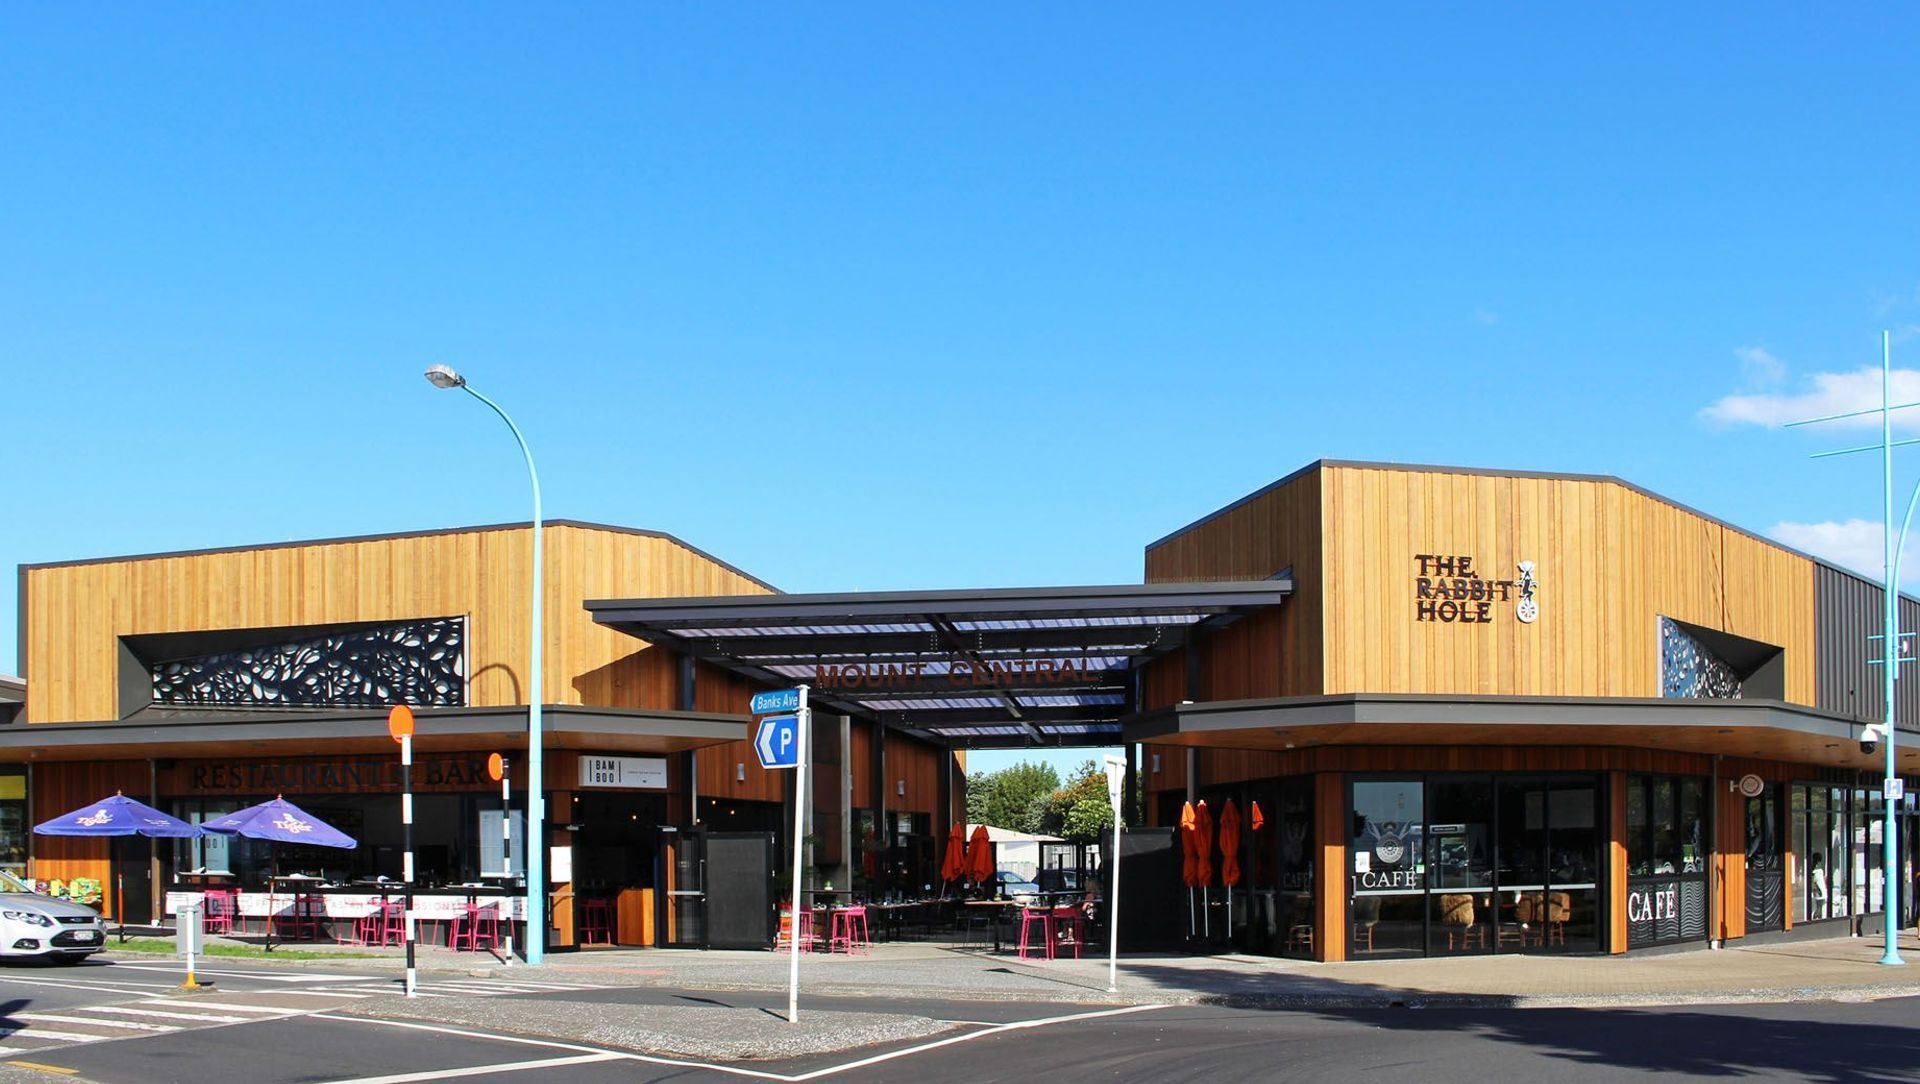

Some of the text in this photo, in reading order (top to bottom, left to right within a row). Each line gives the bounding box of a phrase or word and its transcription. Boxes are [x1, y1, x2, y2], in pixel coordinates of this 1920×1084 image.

[1416, 577, 1513, 601] RABBIT
[1416, 600, 1492, 623] HOLE
[815, 658, 1100, 689] MOUNT CENTRAL
[757, 693, 798, 710] Banks Ave
[780, 727, 792, 755] P
[192, 762, 383, 788] RESTAURANT
[426, 760, 487, 785] BAR
[595, 760, 615, 771] BAM
[595, 773, 615, 783] BOO
[1627, 882, 1676, 922] CAFÉ
